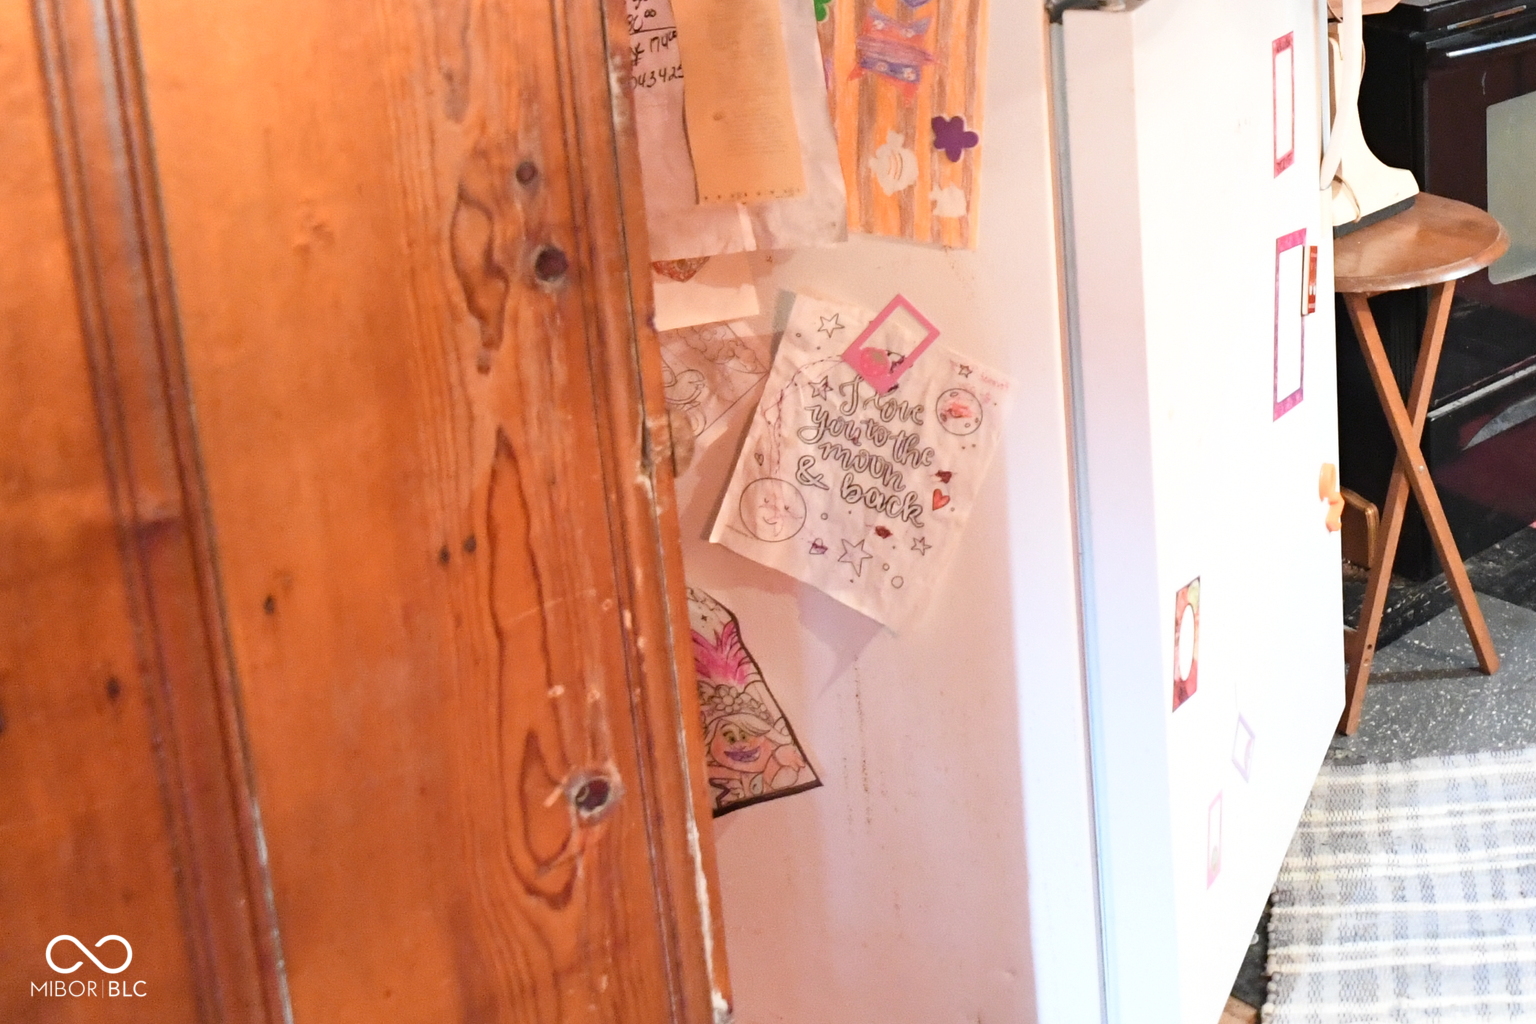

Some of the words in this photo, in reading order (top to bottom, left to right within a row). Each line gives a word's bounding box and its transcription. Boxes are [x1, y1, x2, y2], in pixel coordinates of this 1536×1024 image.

[839, 375, 864, 416] I
[797, 405, 862, 447] you
[861, 418, 891, 447] to
[889, 433, 935, 470] the
[795, 455, 830, 491] &
[840, 473, 925, 527] back
[818, 442, 906, 492] moon
